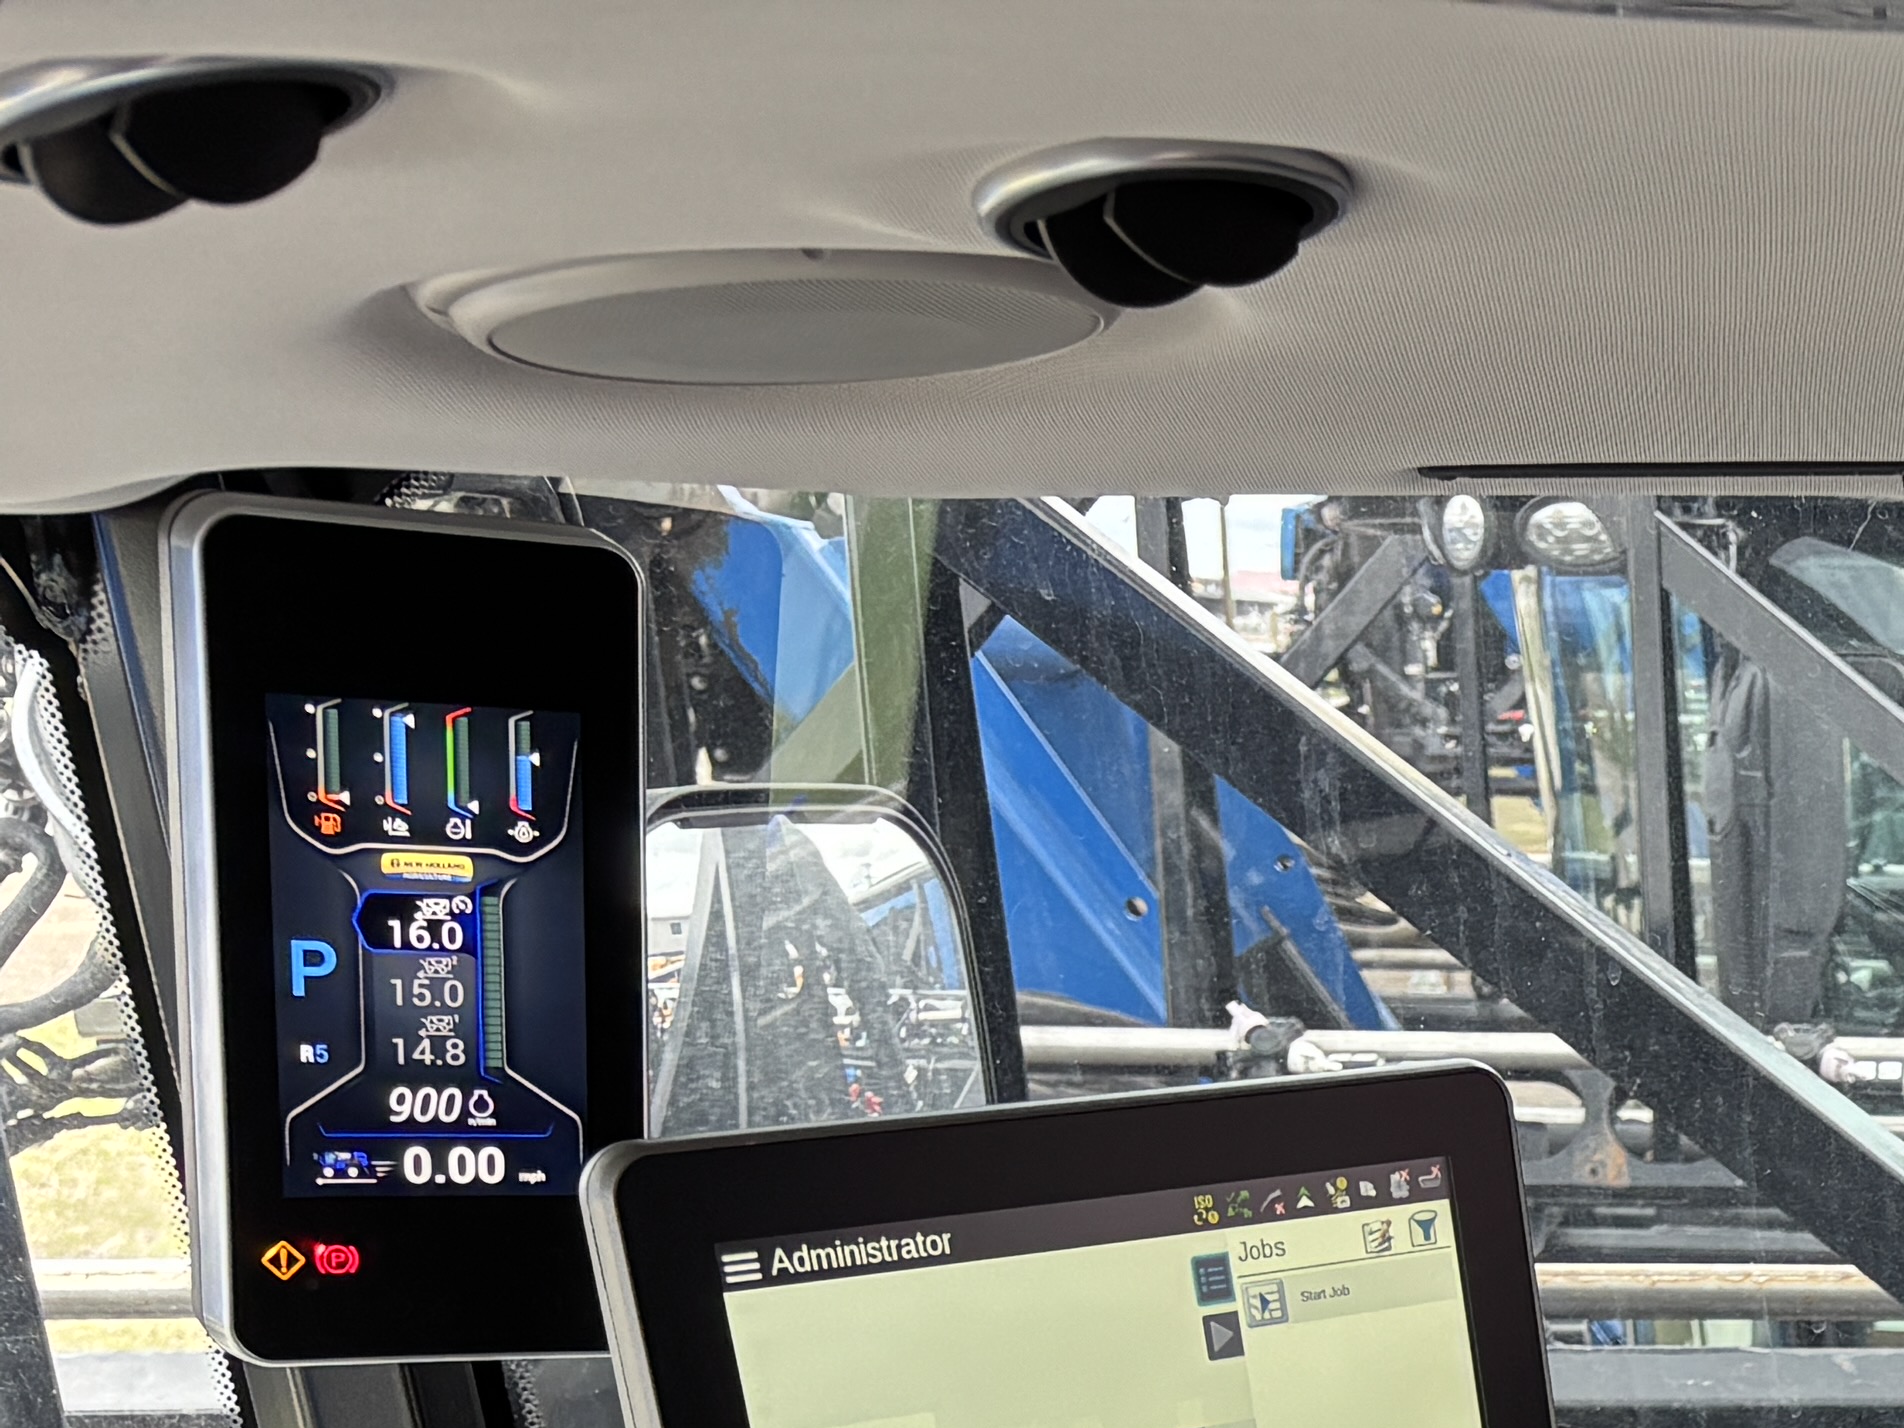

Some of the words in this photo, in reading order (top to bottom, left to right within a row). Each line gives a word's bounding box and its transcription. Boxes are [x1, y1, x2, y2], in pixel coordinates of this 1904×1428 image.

[387, 920, 463, 950] 16.0
[290, 939, 337, 996] P
[390, 979, 464, 1008] 15.0
[299, 1043, 329, 1064] R5
[392, 1038, 466, 1067] 14.8
[388, 1086, 462, 1123] 900
[402, 1146, 505, 1185] 0.00
[518, 1169, 546, 1185] mph
[771, 1231, 951, 1277] Administrator
[1237, 1238, 1287, 1263] Jobs
[1300, 1288, 1327, 1303] Start
[1331, 1284, 1351, 1299] Job
